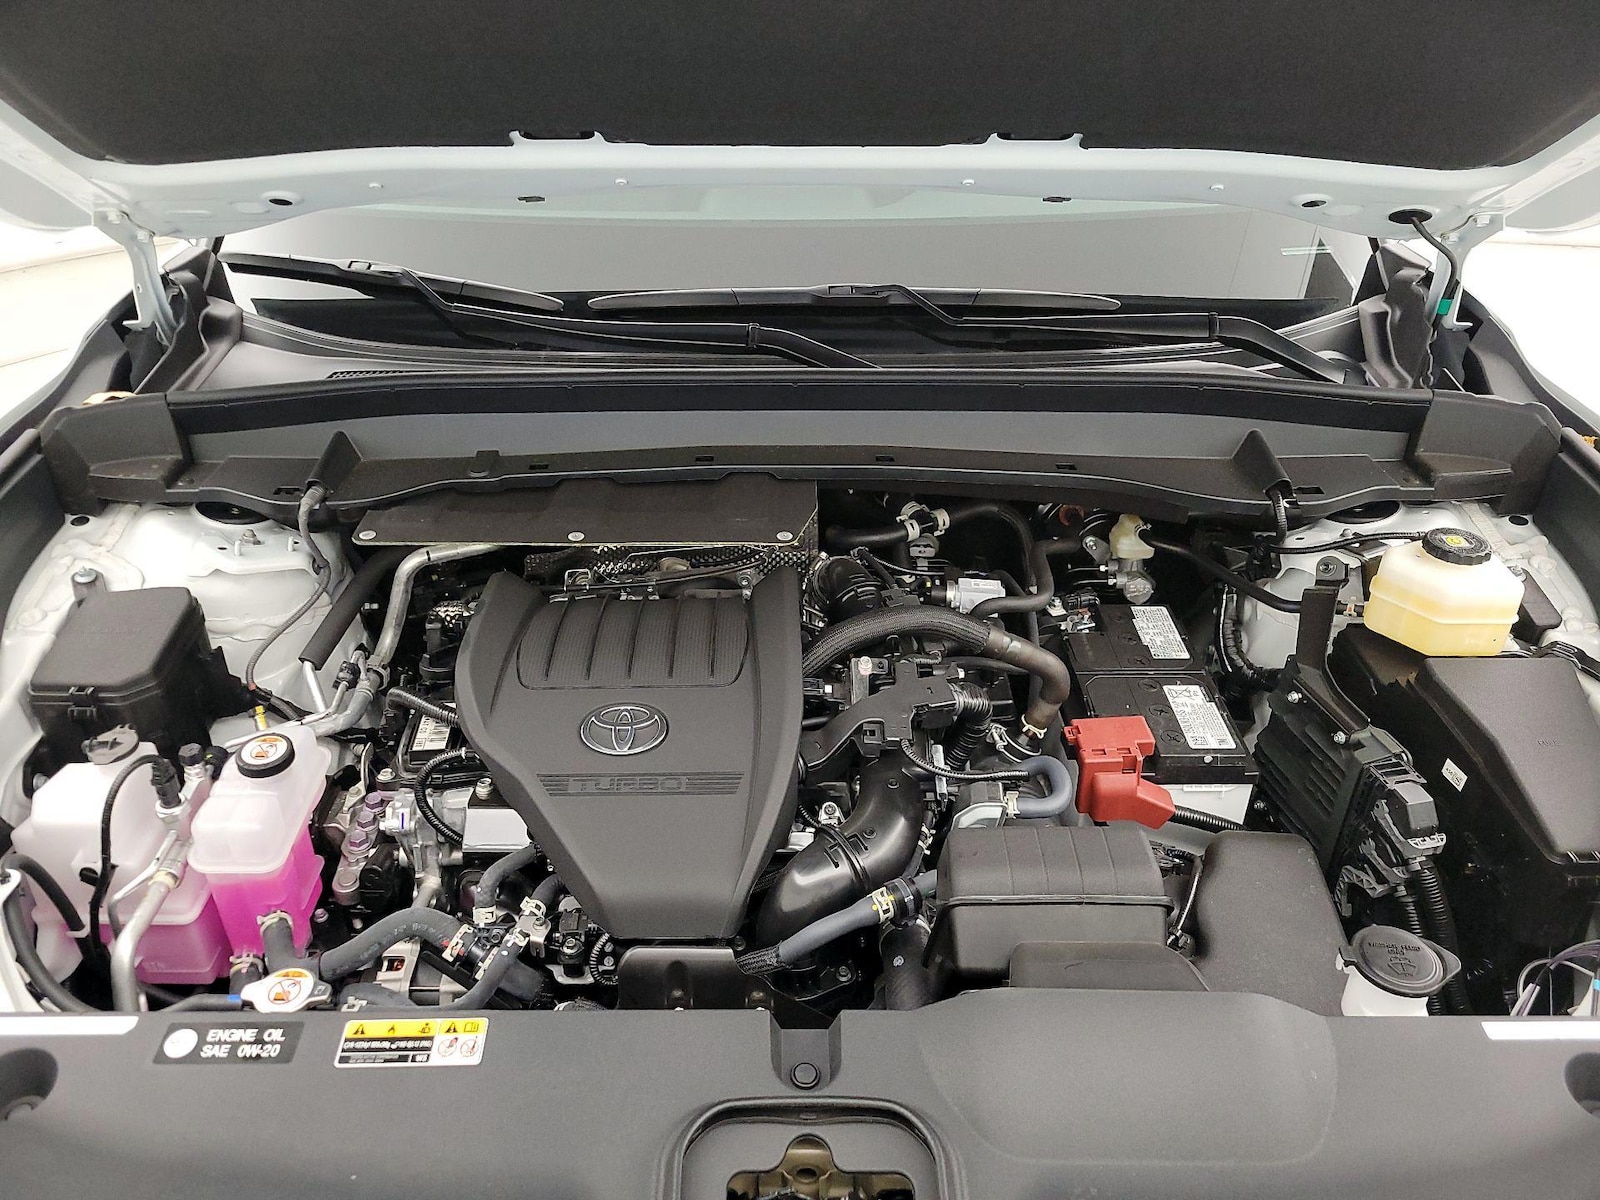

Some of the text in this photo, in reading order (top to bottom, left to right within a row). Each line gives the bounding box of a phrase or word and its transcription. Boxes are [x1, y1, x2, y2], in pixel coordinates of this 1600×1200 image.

[572, 777, 682, 792] TURBO
[206, 1028, 286, 1042] ENGINE OIL
[200, 1044, 281, 1058] SAE 0W-20
